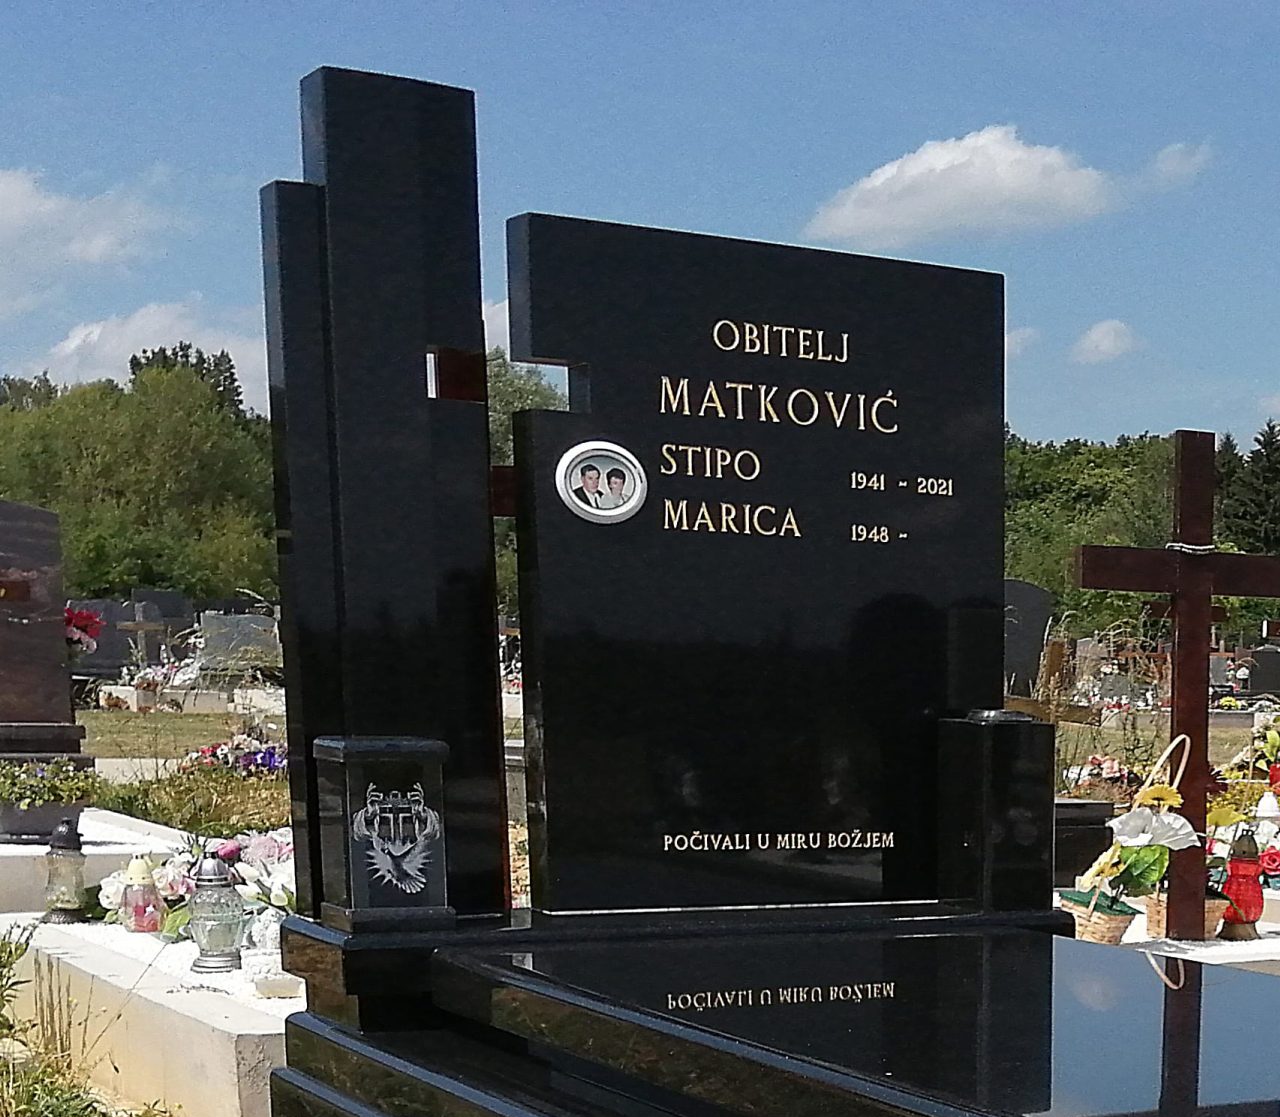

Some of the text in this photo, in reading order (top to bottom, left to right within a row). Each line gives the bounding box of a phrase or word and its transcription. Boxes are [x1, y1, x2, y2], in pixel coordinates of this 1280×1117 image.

[712, 319, 849, 363] OBITELJ
[659, 375, 898, 434] MATKOVIĆ
[660, 443, 761, 481] STIPO
[851, 471, 885, 491] 1941
[917, 477, 953, 496] 2021
[663, 498, 802, 538] MARICA
[851, 524, 890, 543] 1948
[663, 829, 895, 851] POČIVALI U MIRU BOŽJEM
